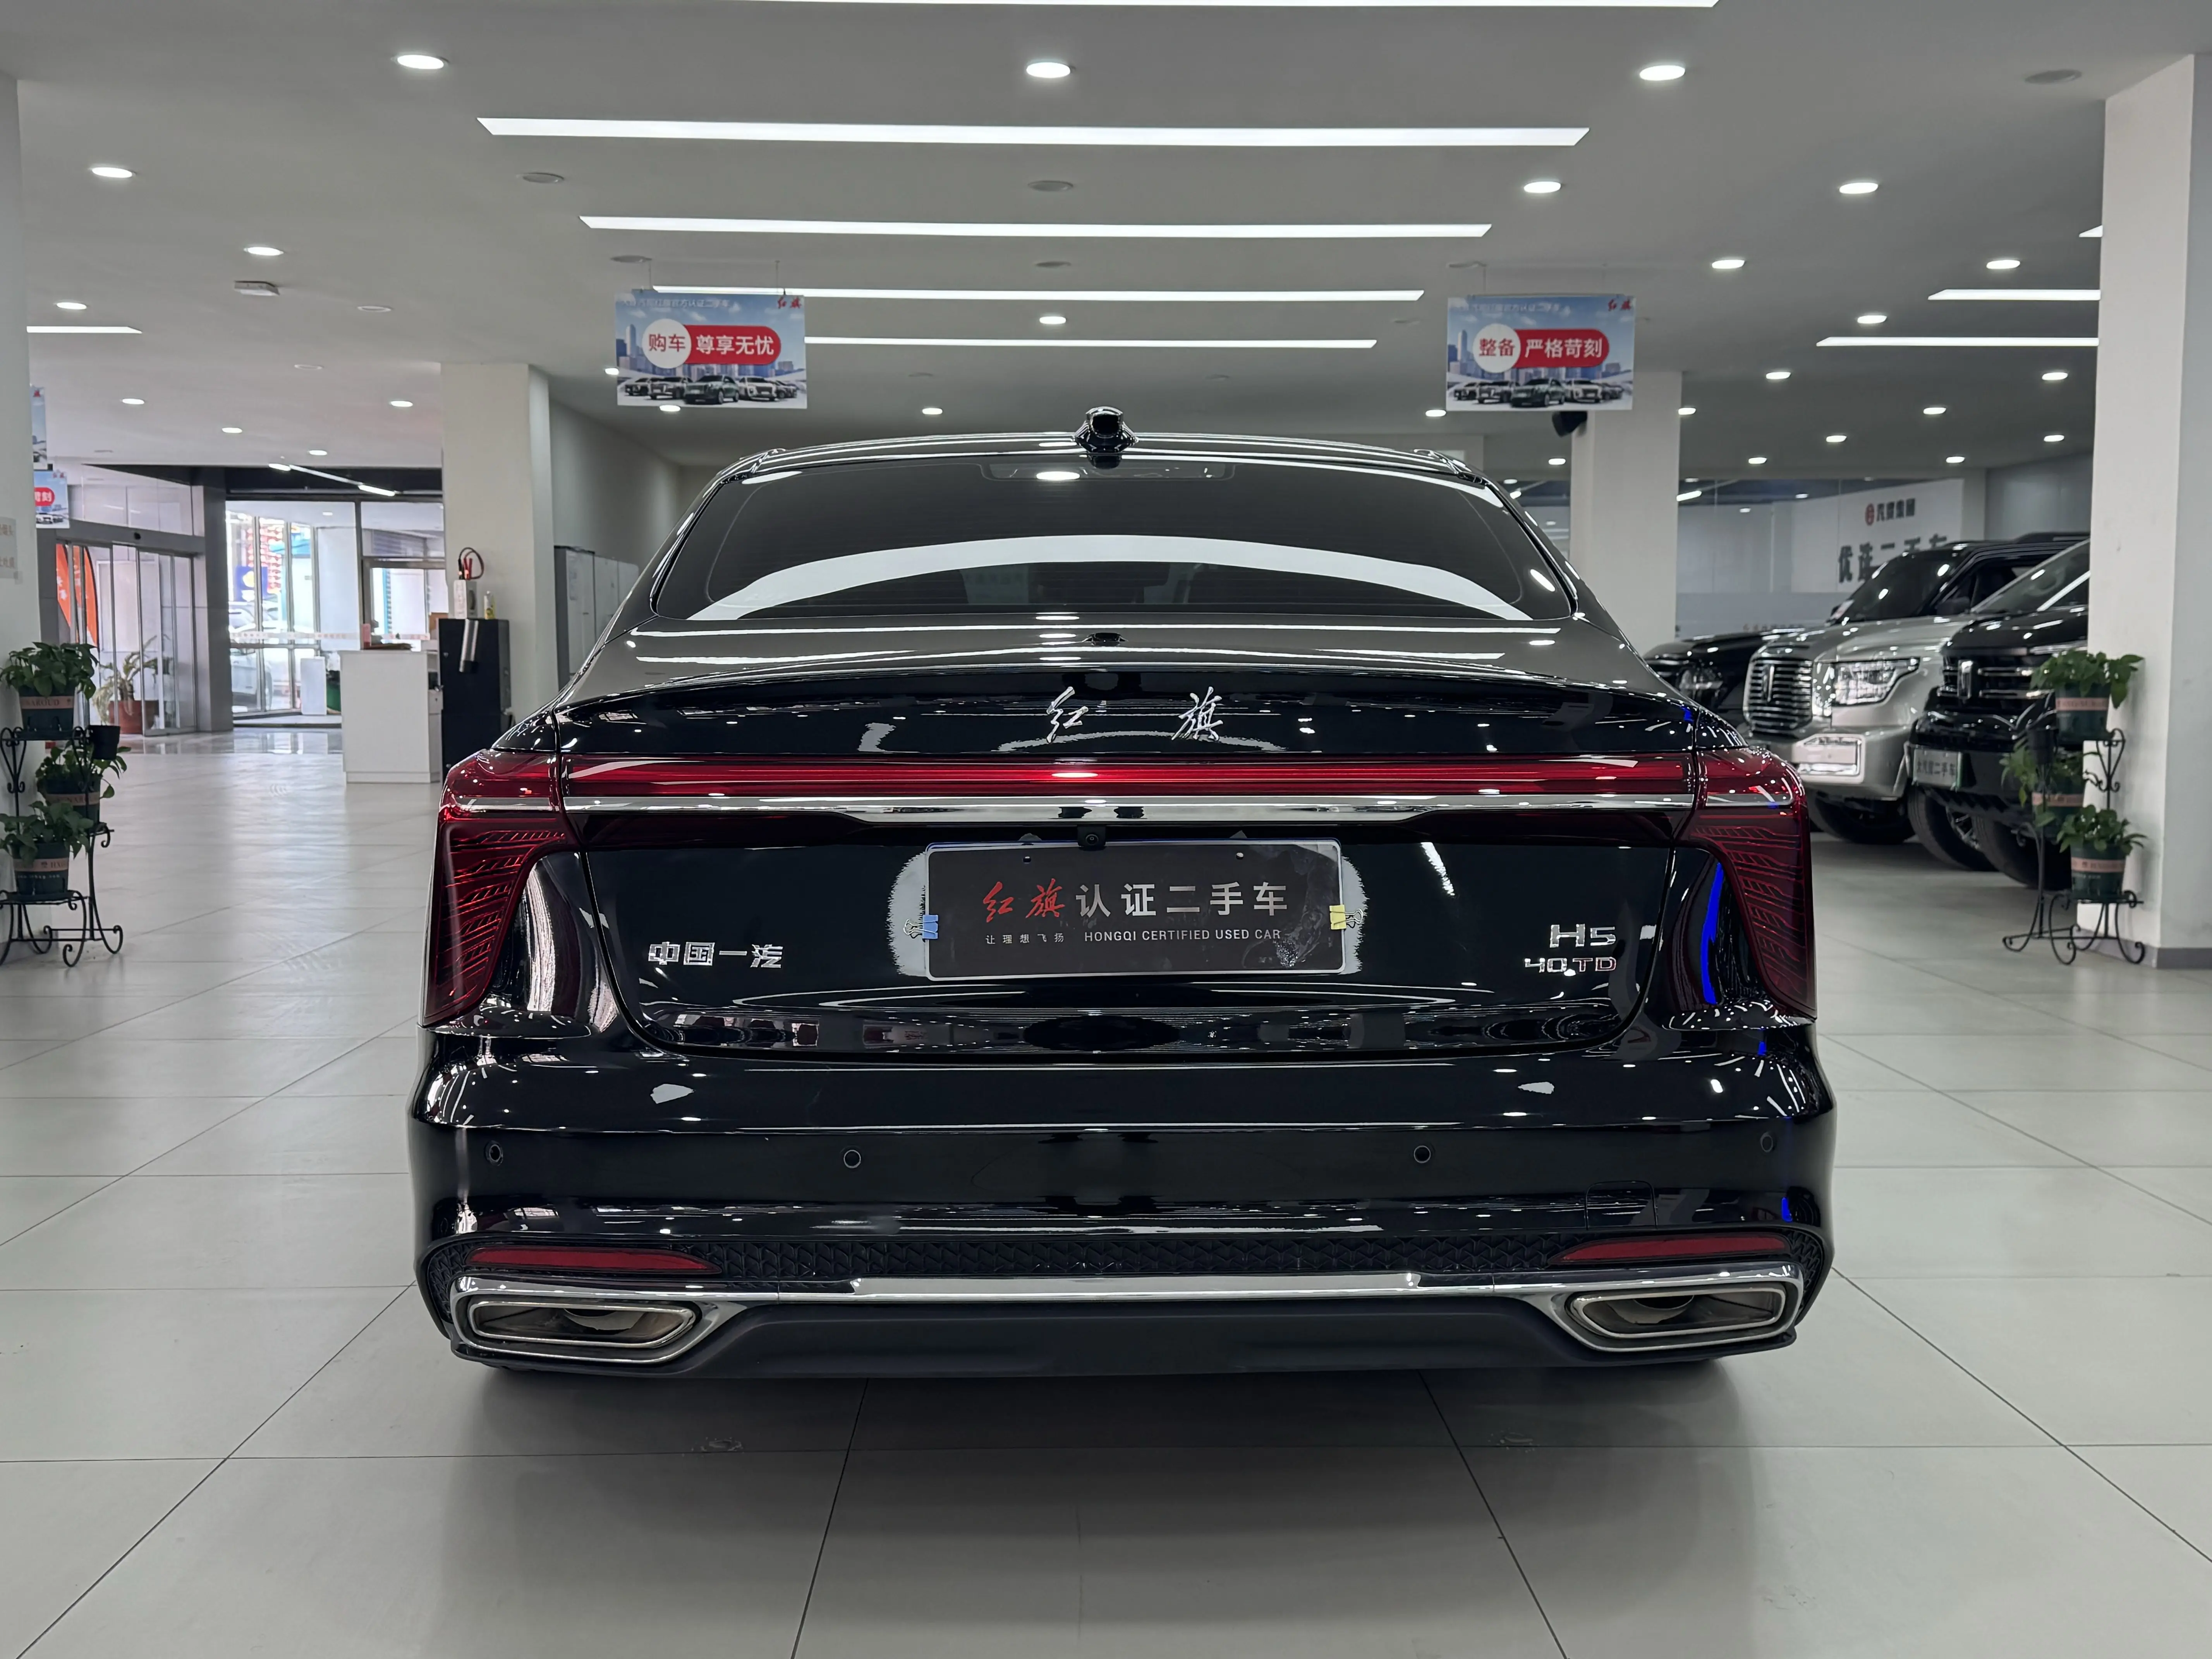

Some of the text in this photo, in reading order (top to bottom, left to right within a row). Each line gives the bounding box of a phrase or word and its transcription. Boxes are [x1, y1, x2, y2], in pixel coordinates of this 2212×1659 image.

[648, 333, 774, 355] 购车 尊享无忧
[1479, 338, 1603, 358] 整备 严格苛刻
[1046, 686, 1223, 743] 红旗
[983, 878, 1287, 923] 红旗认证二手车
[986, 932, 1065, 945] 让理想飞扬
[1085, 929, 1281, 942] HONGQI CERTIFIED USED CAR
[1549, 924, 1616, 948] H5
[648, 941, 783, 968] 中国一汽
[1524, 957, 1616, 973] 40TD
